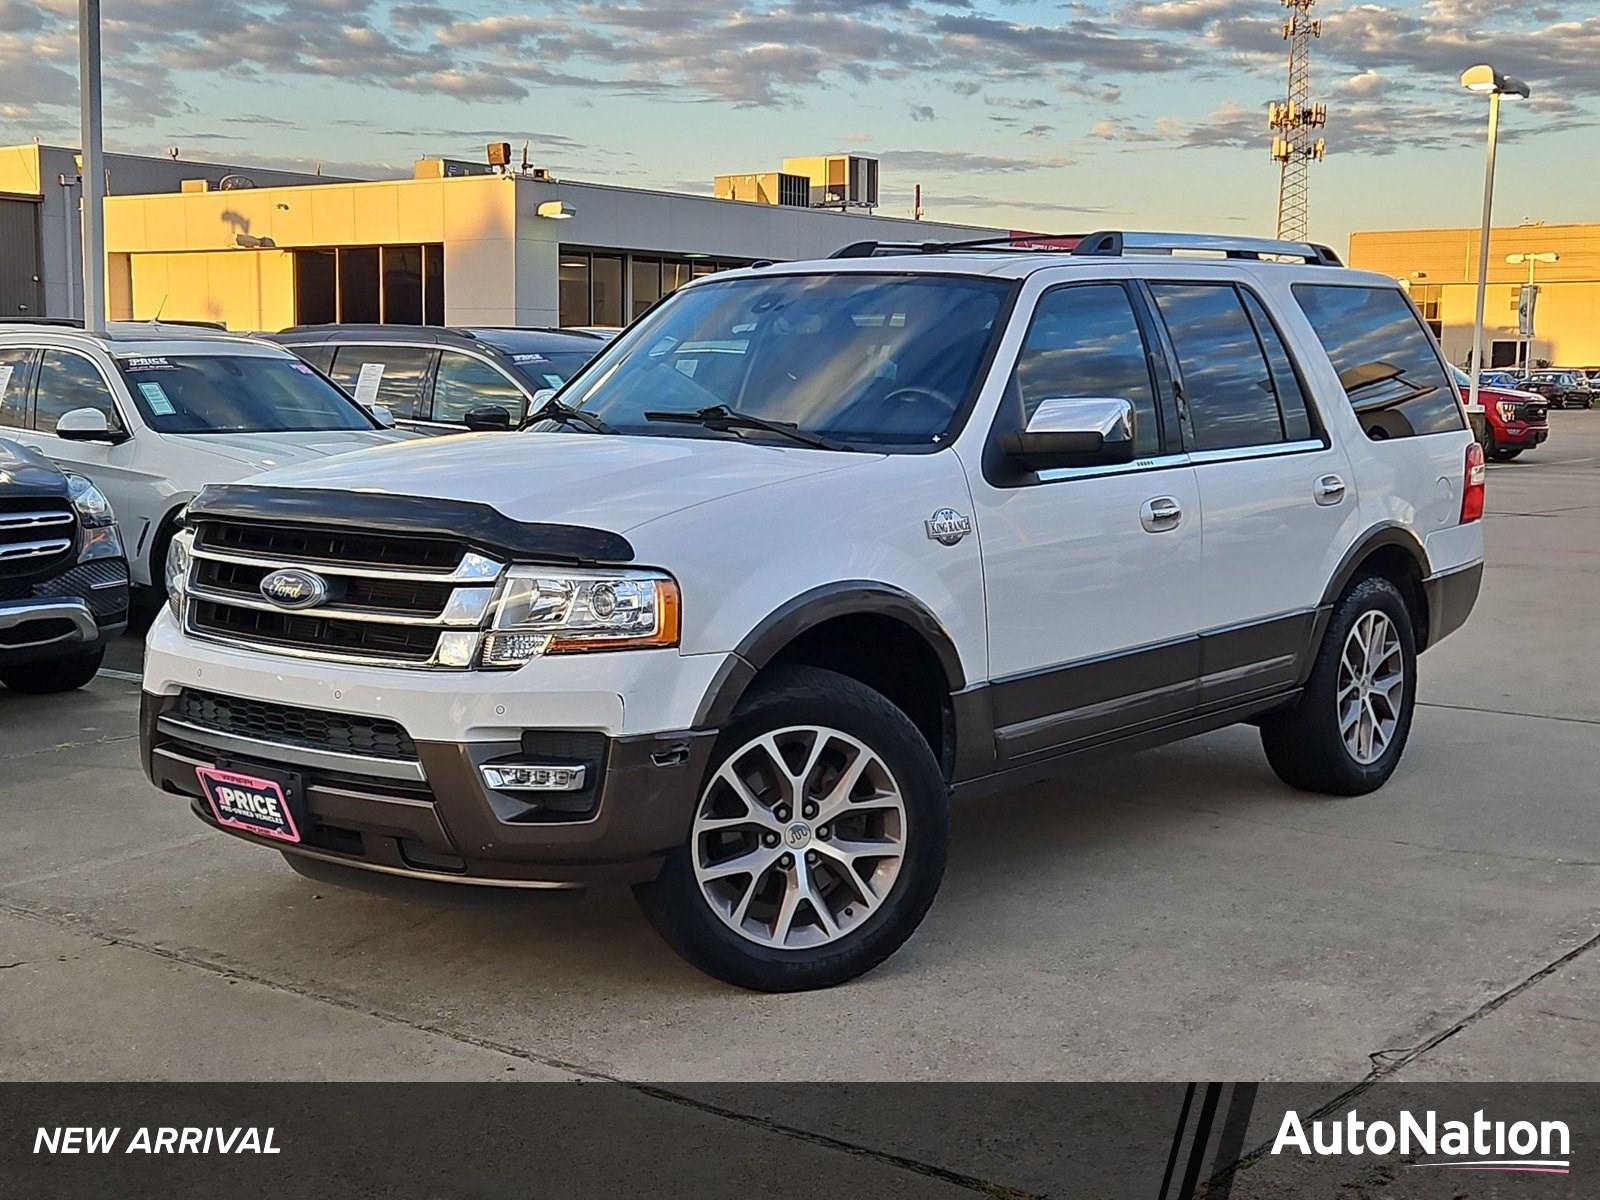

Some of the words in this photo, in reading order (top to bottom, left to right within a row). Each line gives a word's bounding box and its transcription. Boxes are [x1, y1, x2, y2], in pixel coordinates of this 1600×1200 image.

[930, 521, 948, 535] KING
[948, 517, 971, 532] RANCH
[269, 576, 303, 599] Ford
[255, 812, 284, 825] VEHICLES
